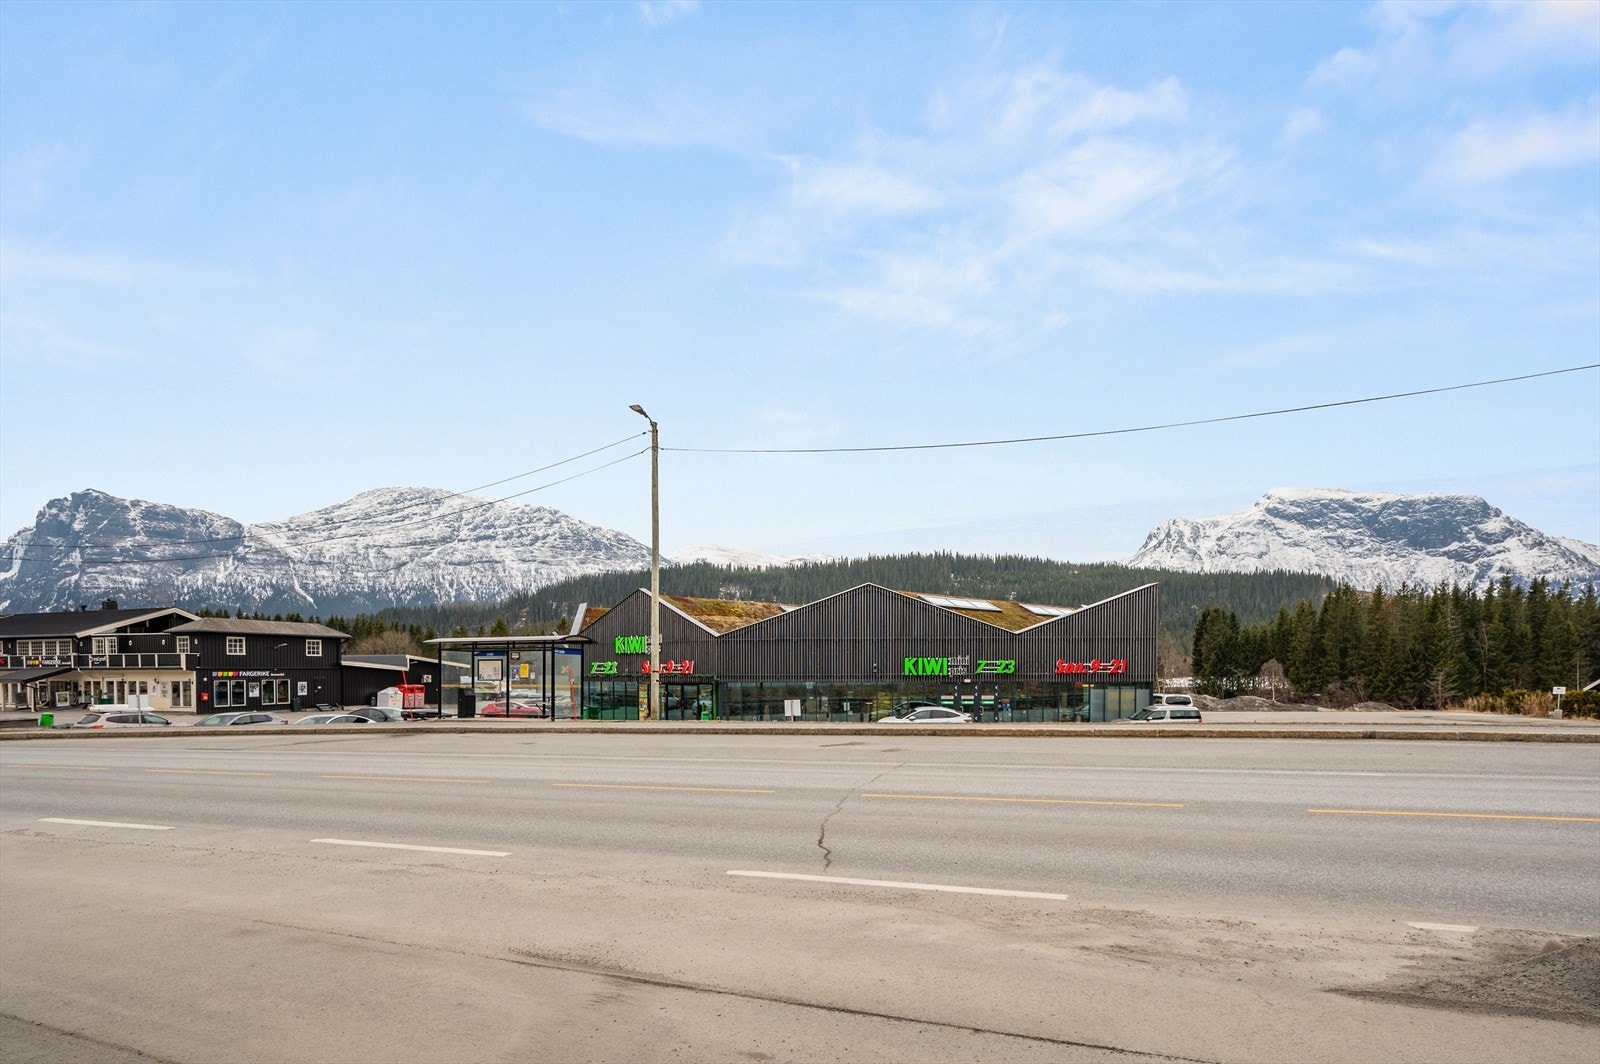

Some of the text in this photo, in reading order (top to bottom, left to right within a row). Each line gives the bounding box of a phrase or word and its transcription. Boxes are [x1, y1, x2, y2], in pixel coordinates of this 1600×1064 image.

[615, 635, 646, 654] KIWI
[903, 657, 949, 676] KIWI
[948, 655, 970, 665] mini
[948, 665, 968, 678] pris
